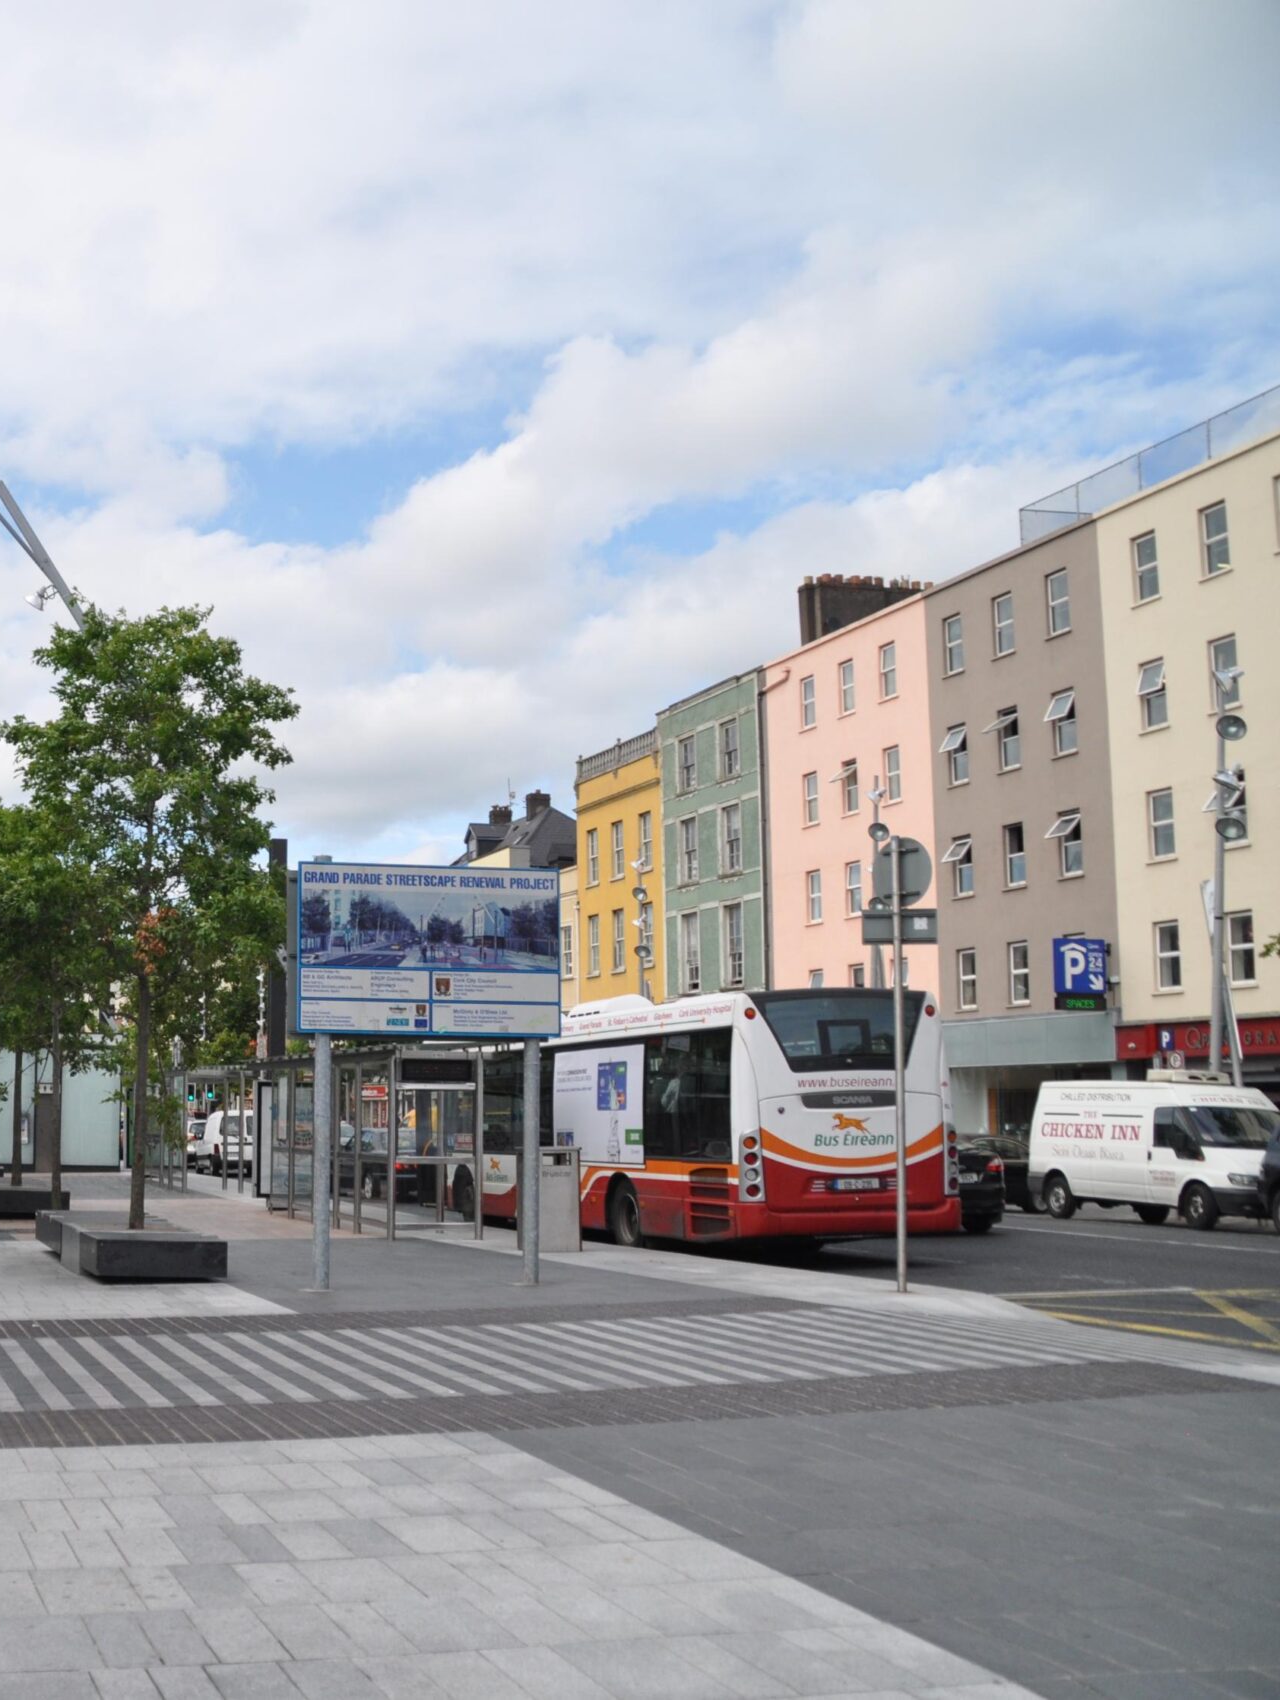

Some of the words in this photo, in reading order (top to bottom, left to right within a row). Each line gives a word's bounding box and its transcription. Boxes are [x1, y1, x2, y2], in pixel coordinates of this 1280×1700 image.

[303, 871, 340, 884] GRAND
[342, 872, 384, 886] PARADE
[385, 873, 457, 888] STREETSCAPE
[459, 876, 507, 889] RENEWAL
[509, 877, 555, 890] PROJECT
[1065, 950, 1086, 990] P
[1088, 957, 1104, 968] 24
[1066, 999, 1096, 1009] SPACES
[1161, 1031, 1170, 1048] P
[1244, 1030, 1277, 1045] GRA
[797, 1077, 897, 1089] www.buseireann.
[832, 1095, 873, 1105] SCANIA
[1083, 1111, 1099, 1119] THE
[1041, 1121, 1106, 1140] CHICKEN
[1111, 1124, 1141, 1141] INN
[814, 1134, 839, 1147] Bus
[843, 1131, 895, 1147] Éireann
